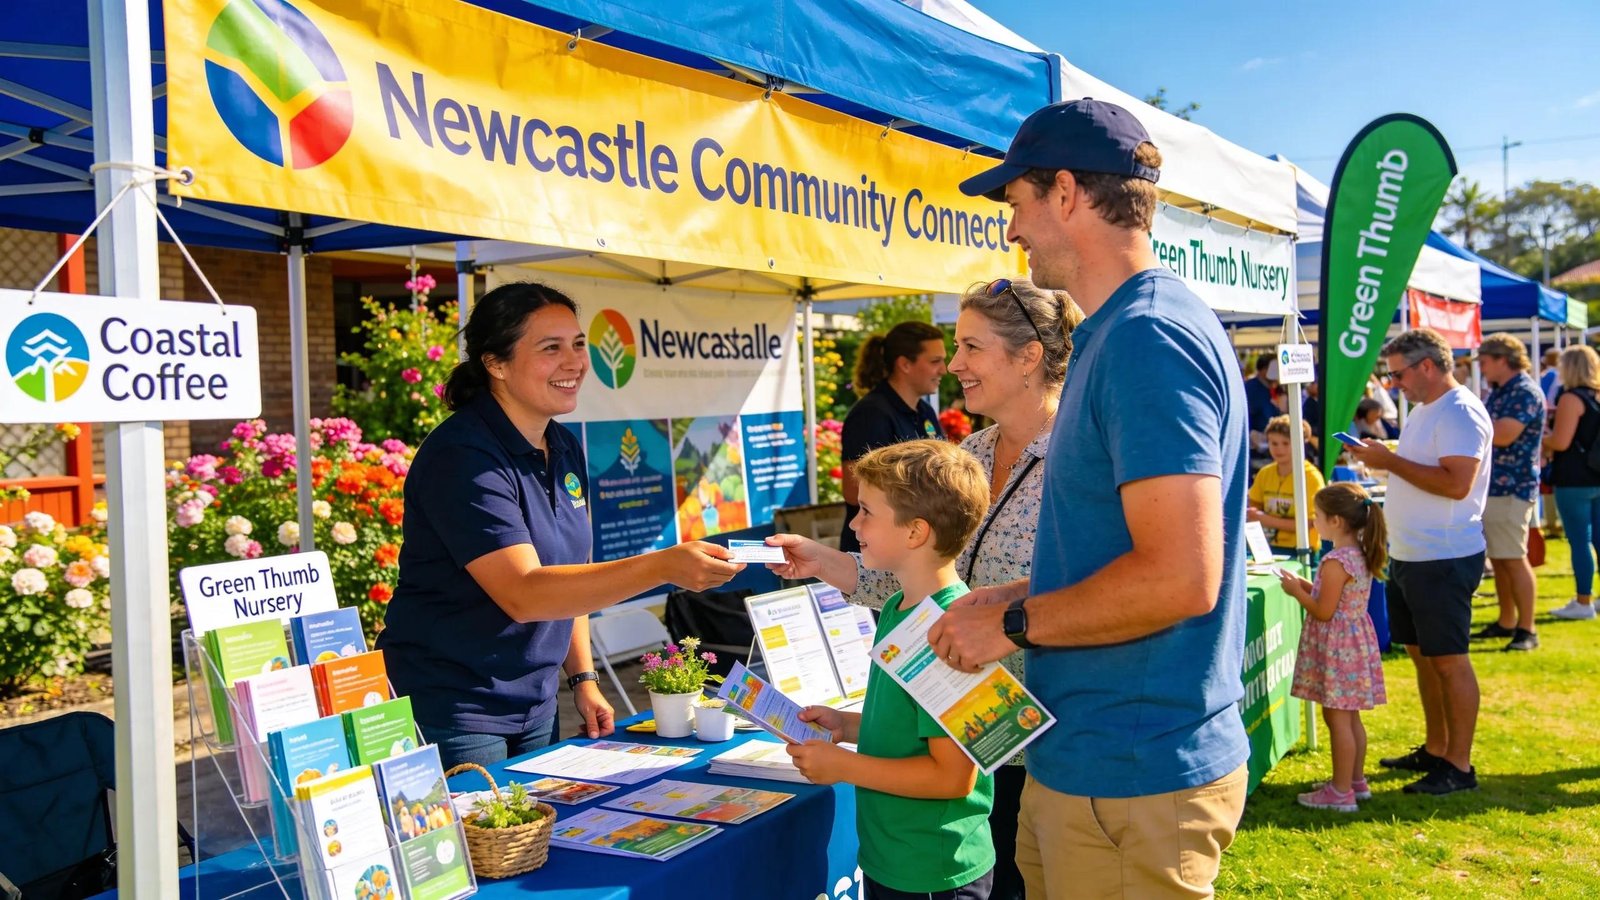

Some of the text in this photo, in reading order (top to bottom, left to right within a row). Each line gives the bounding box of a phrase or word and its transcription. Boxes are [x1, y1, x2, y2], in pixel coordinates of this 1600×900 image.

[376, 61, 1010, 252] Newcastle Community Connect
[1148, 231, 1289, 301] reen Thumb Nursery
[1338, 149, 1408, 358] Green Thumb
[100, 317, 242, 358] Coastal
[102, 363, 228, 401] Coffee
[199, 563, 320, 598] Green Thumb
[233, 592, 303, 619] Nursery
